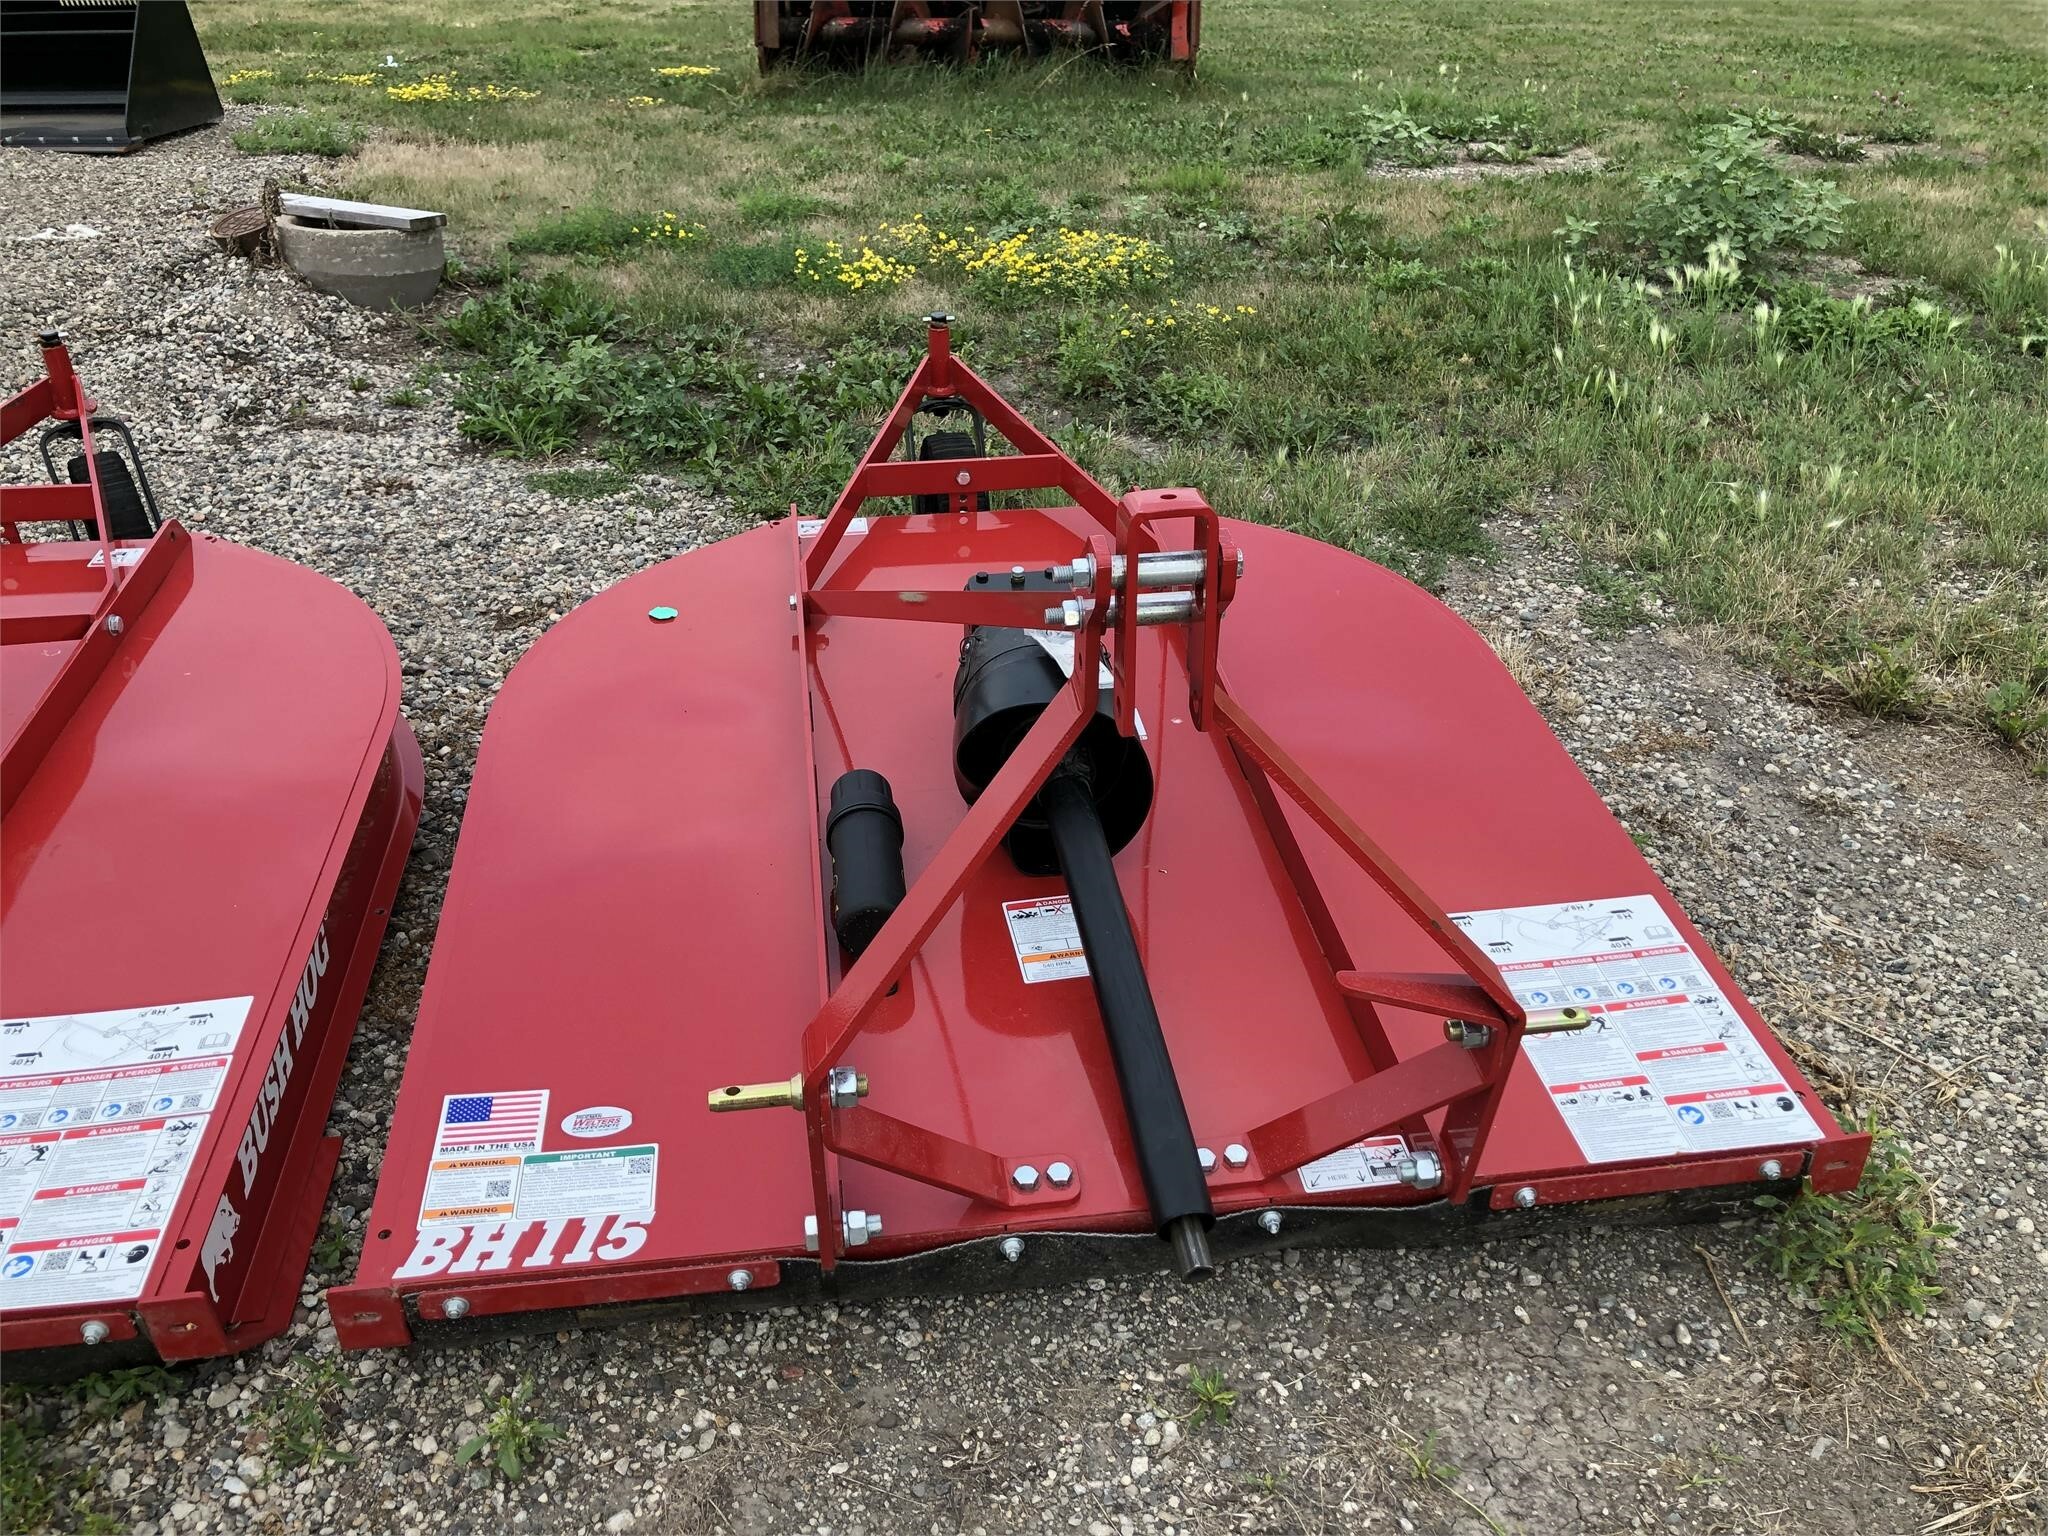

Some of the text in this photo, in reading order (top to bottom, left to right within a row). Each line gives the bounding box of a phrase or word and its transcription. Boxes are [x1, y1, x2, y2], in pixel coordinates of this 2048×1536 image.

[1508, 962, 1544, 971] PELIGRO
[1560, 957, 1594, 966] DANGER
[1634, 998, 1669, 1008] DANGER
[1670, 1046, 1707, 1057] DANGER
[180, 1060, 219, 1070] GEFAHR
[237, 924, 330, 1200] BUSH HOG
[123, 1067, 162, 1077] PERIGO
[72, 1073, 113, 1083] DANGER
[9, 1079, 53, 1088] PELIGRO
[1587, 1080, 1624, 1091] DANGER
[1714, 1089, 1750, 1099] DANGER
[572, 1117, 622, 1128] WELTERS
[99, 1124, 141, 1135] DANGER
[0, 1136, 32, 1146] ANGER
[440, 1145, 471, 1153] MADE
[474, 1143, 485, 1151] IN
[490, 1142, 510, 1150] THE
[559, 1150, 617, 1161] IMPORTANT
[459, 1159, 506, 1168] WARNING
[76, 1183, 120, 1194] DANGER
[450, 1206, 499, 1216] WARNING
[69, 1236, 114, 1247] DANGER
